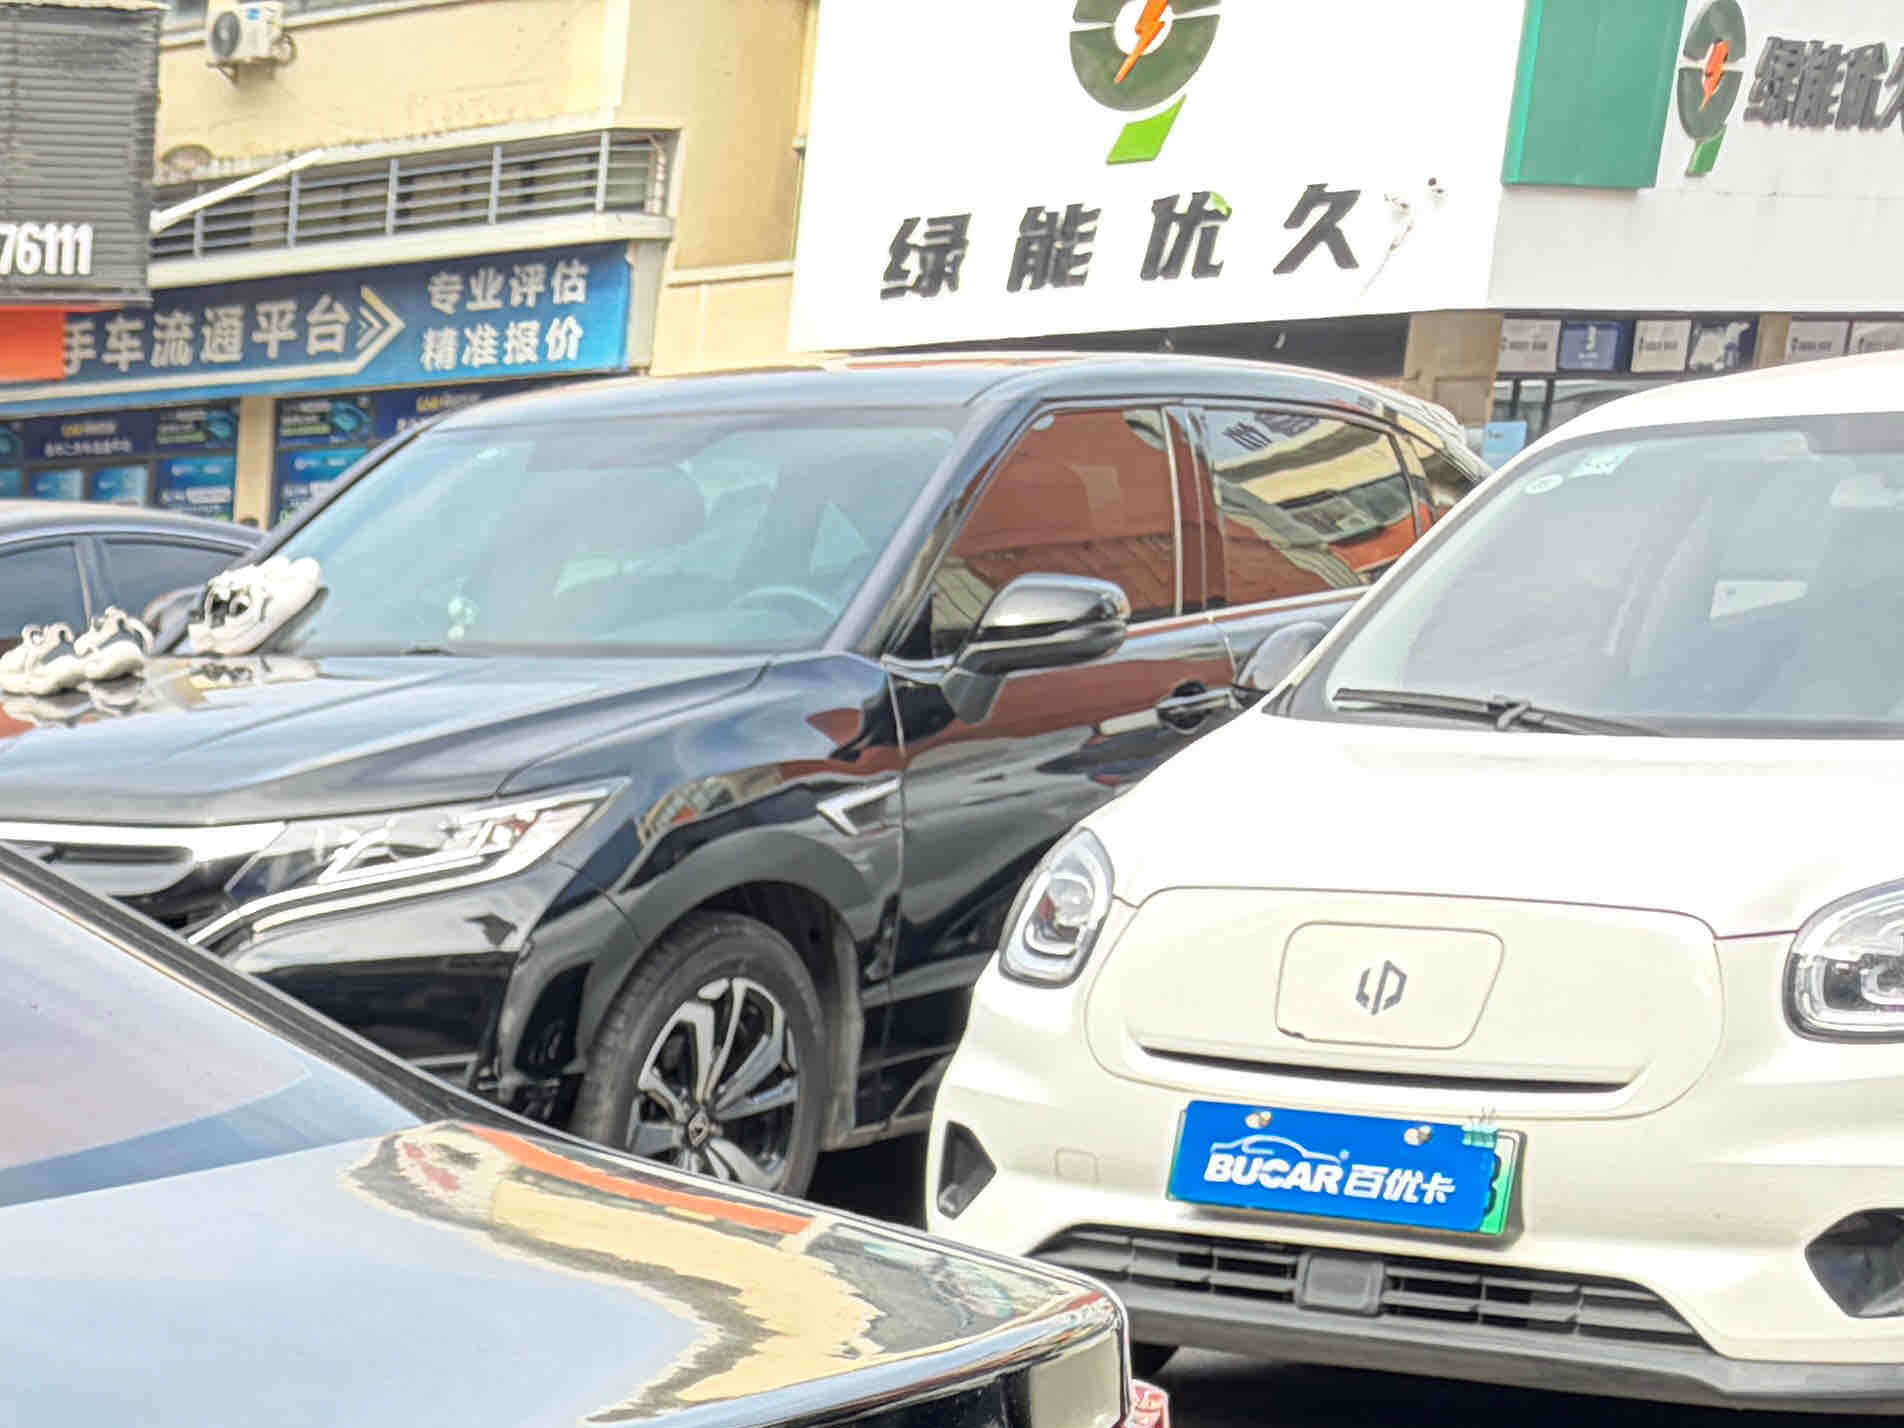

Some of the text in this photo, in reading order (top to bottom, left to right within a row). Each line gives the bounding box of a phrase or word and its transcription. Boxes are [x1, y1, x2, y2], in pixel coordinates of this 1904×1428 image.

[880, 183, 1361, 300] 绿能优久
[427, 258, 590, 316] 专业评估
[419, 314, 583, 373] 精准报价
[1203, 1153, 1456, 1205] BUCAR 百优卡
